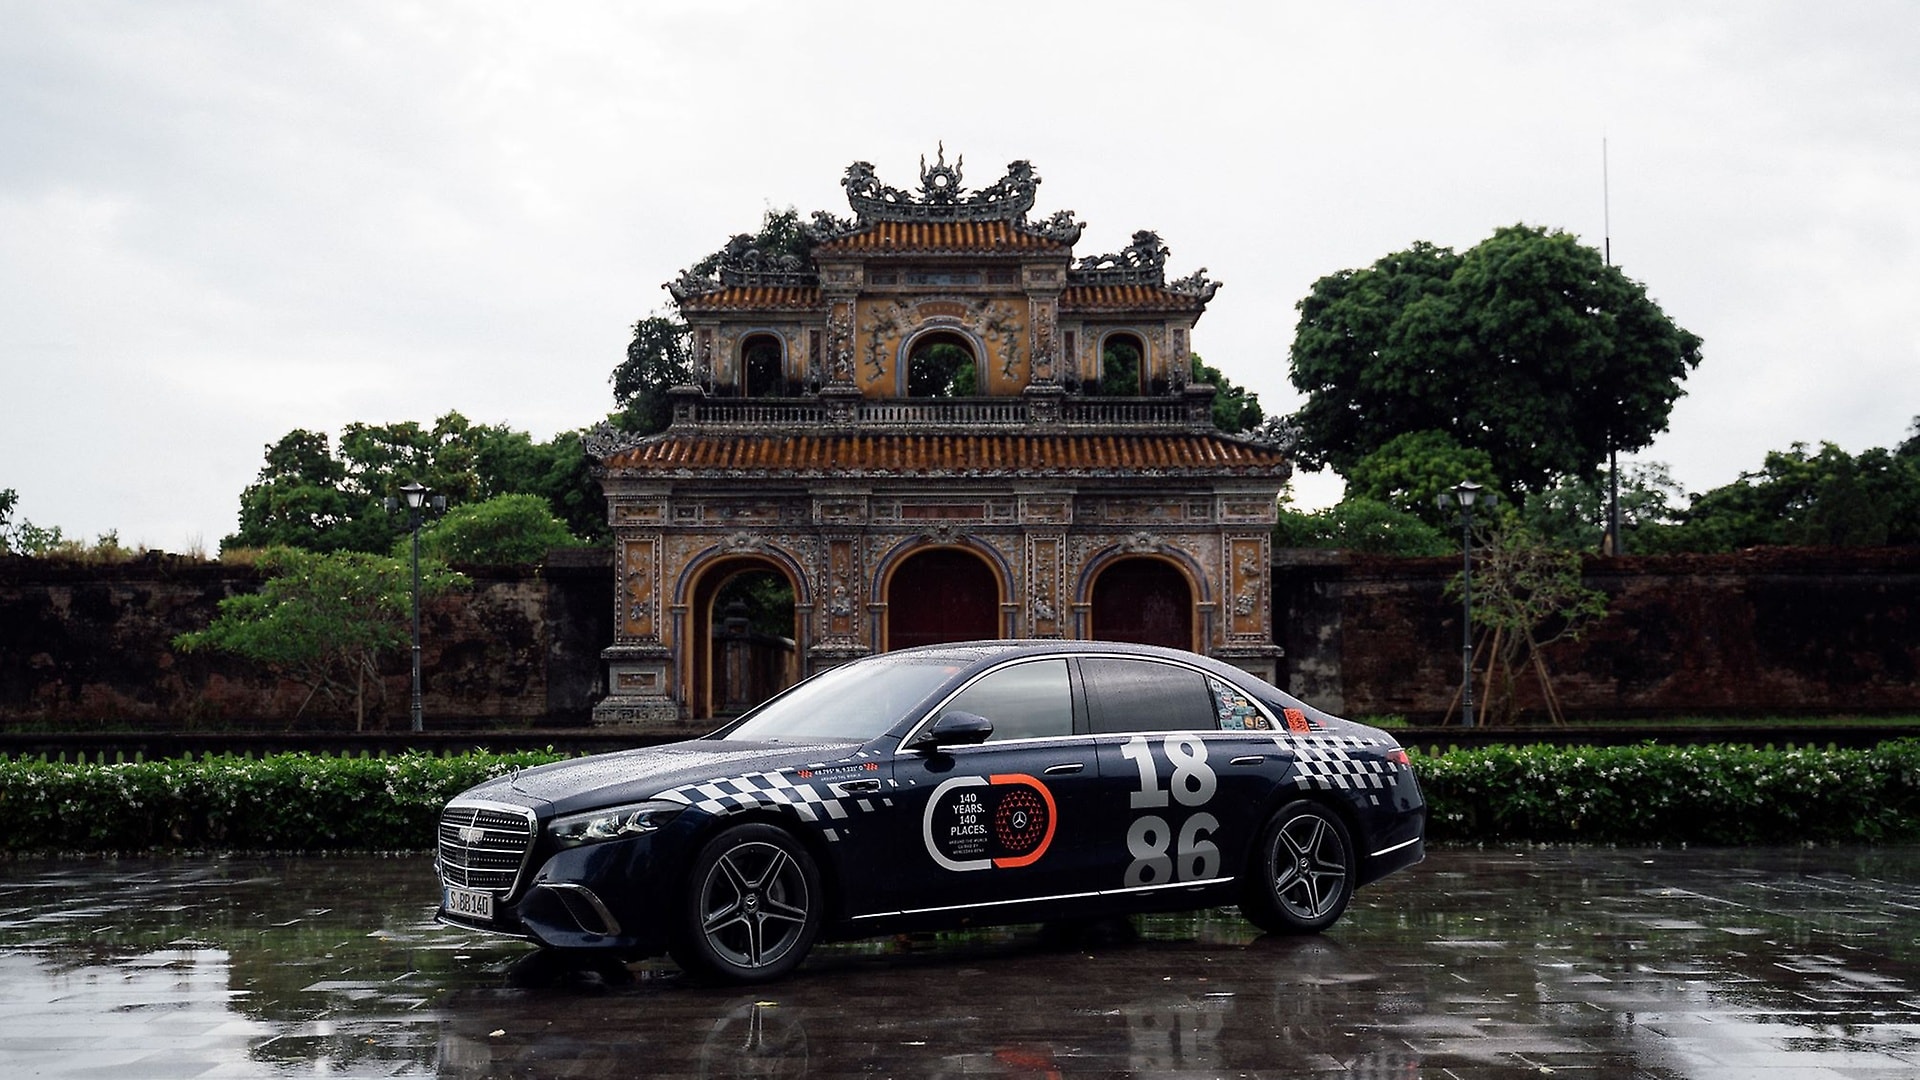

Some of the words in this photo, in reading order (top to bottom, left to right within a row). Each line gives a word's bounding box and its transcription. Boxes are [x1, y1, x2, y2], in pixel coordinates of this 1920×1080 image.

[1120, 734, 1217, 809] 18
[959, 793, 977, 803] 140
[952, 803, 986, 814] YEARS.
[959, 814, 977, 825] 140
[950, 824, 988, 836] PLACES.
[1123, 812, 1221, 888] 86
